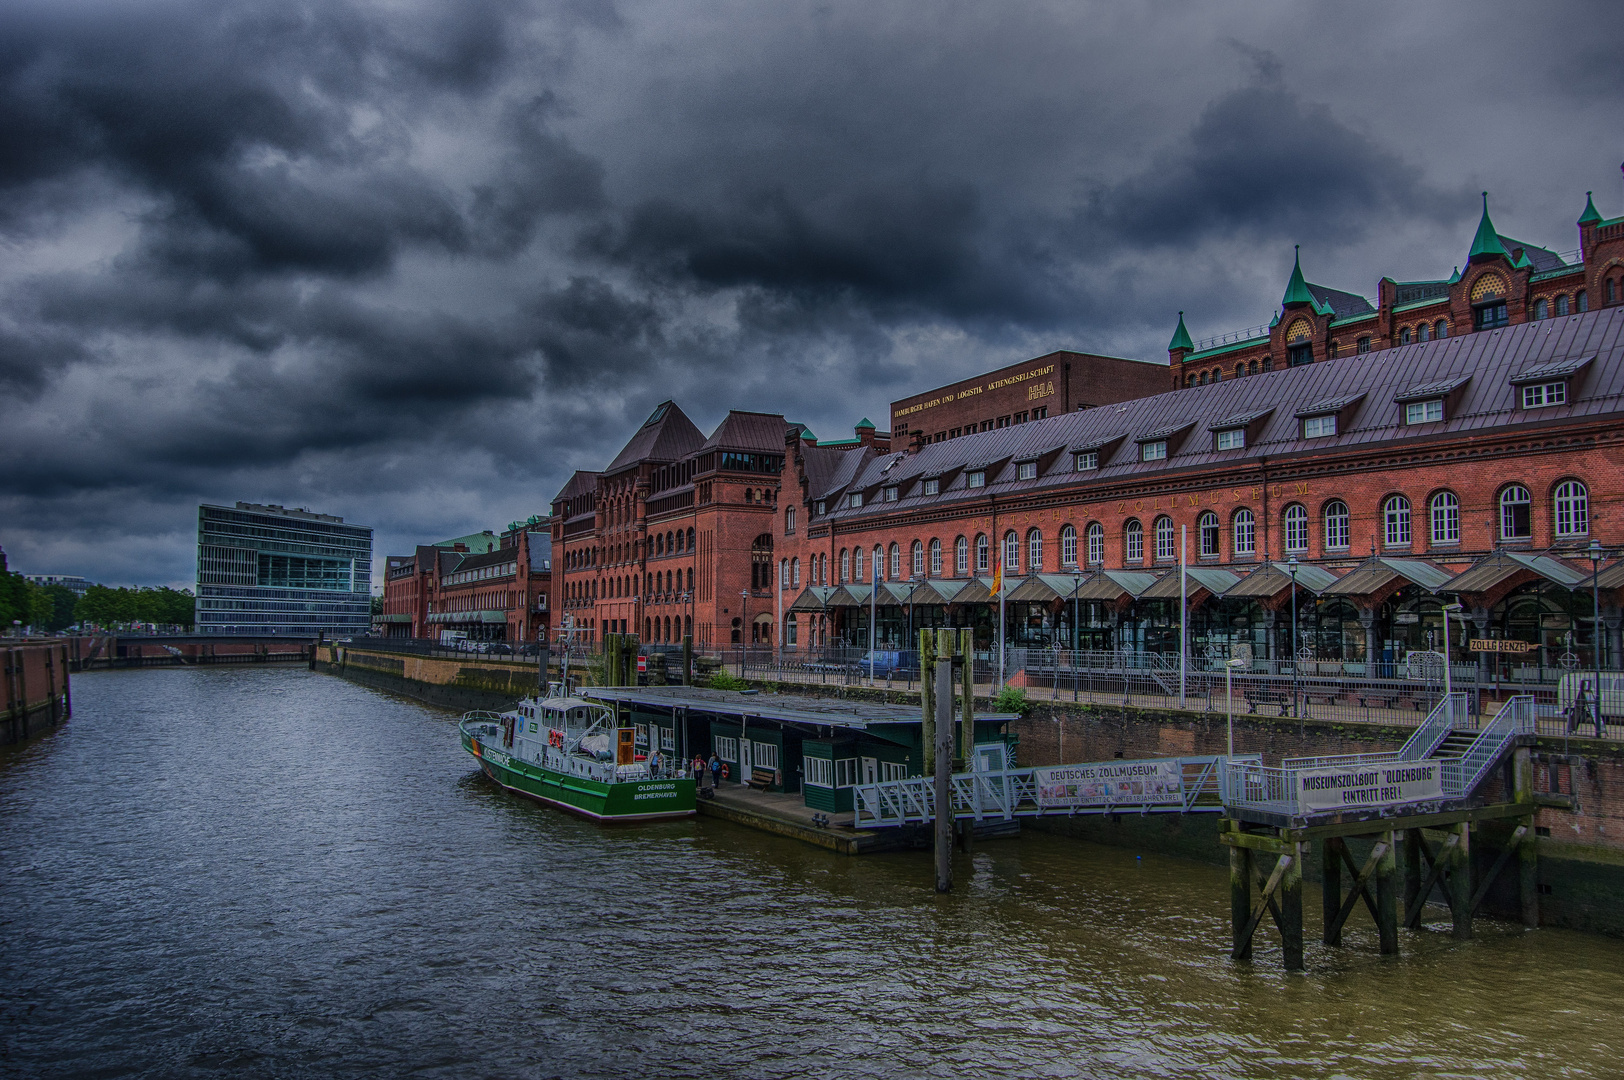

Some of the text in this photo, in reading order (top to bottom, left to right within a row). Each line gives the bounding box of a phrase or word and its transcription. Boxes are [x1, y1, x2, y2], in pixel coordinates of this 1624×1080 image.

[894, 364, 1055, 418] HAMBURGER HAFEN UND LOGISTIK AKTIENGESELLSCHAFT
[1028, 381, 1054, 400] HHLA
[972, 482, 1310, 529] DEUTSCHES ZOLLMUSEUM
[1471, 640, 1525, 652] ZOLLGRENZE
[1050, 768, 1095, 781] DEUTSCHES
[1099, 765, 1158, 778] ZOLLMUSEUM
[1303, 766, 1437, 791] MUSEUMSZOLLBOOT "OLDENBURG"
[634, 791, 678, 800] BREMERHAVEN
[637, 783, 676, 792] OLDENBURG
[1140, 794, 1164, 802] JAHREN
[1342, 788, 1379, 804] EINTRITT
